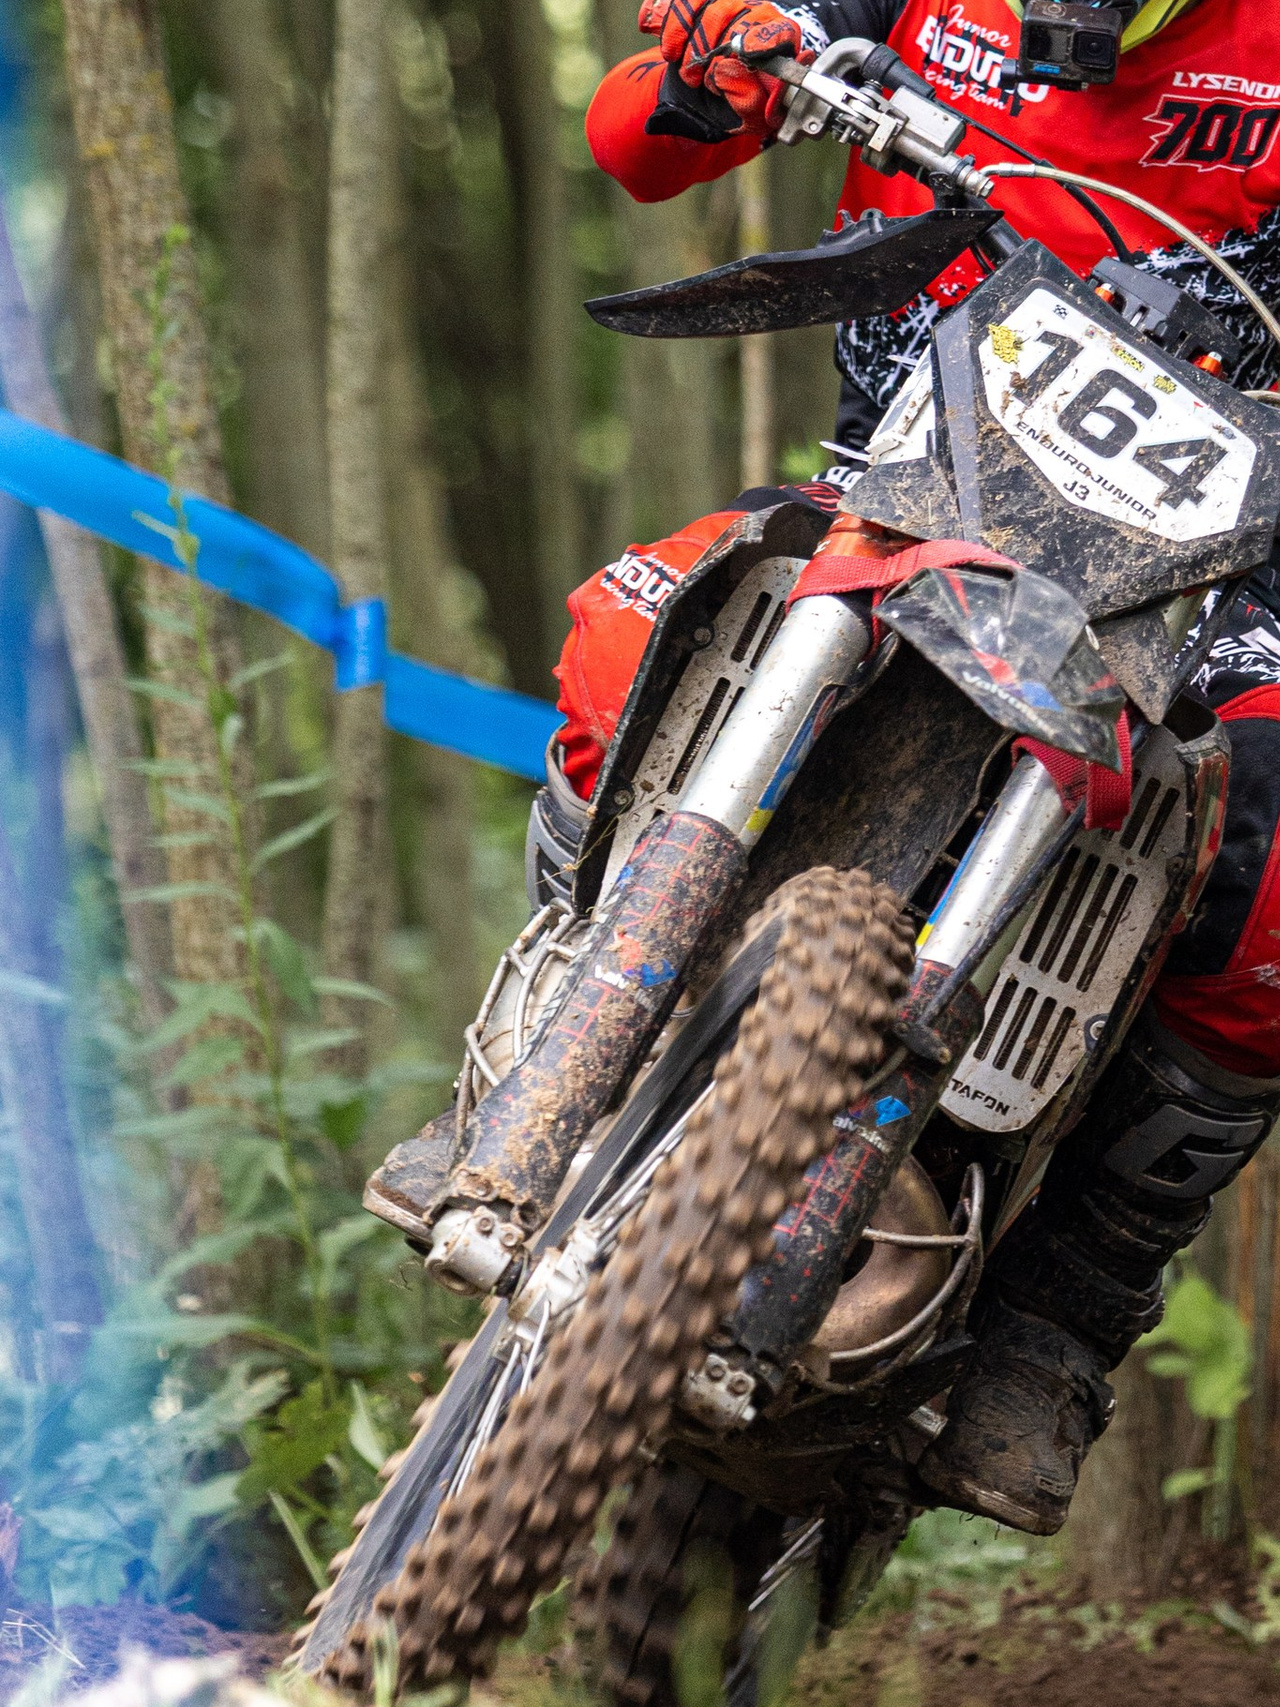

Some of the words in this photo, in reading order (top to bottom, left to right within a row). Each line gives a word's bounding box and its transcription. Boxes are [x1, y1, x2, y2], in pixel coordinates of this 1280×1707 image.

[969, 81, 1006, 110] team
[1008, 330, 1229, 510] 164
[1015, 421, 1091, 475] ENDURO
[1090, 474, 1157, 520] JUNIOR
[1063, 481, 1090, 502] J3
